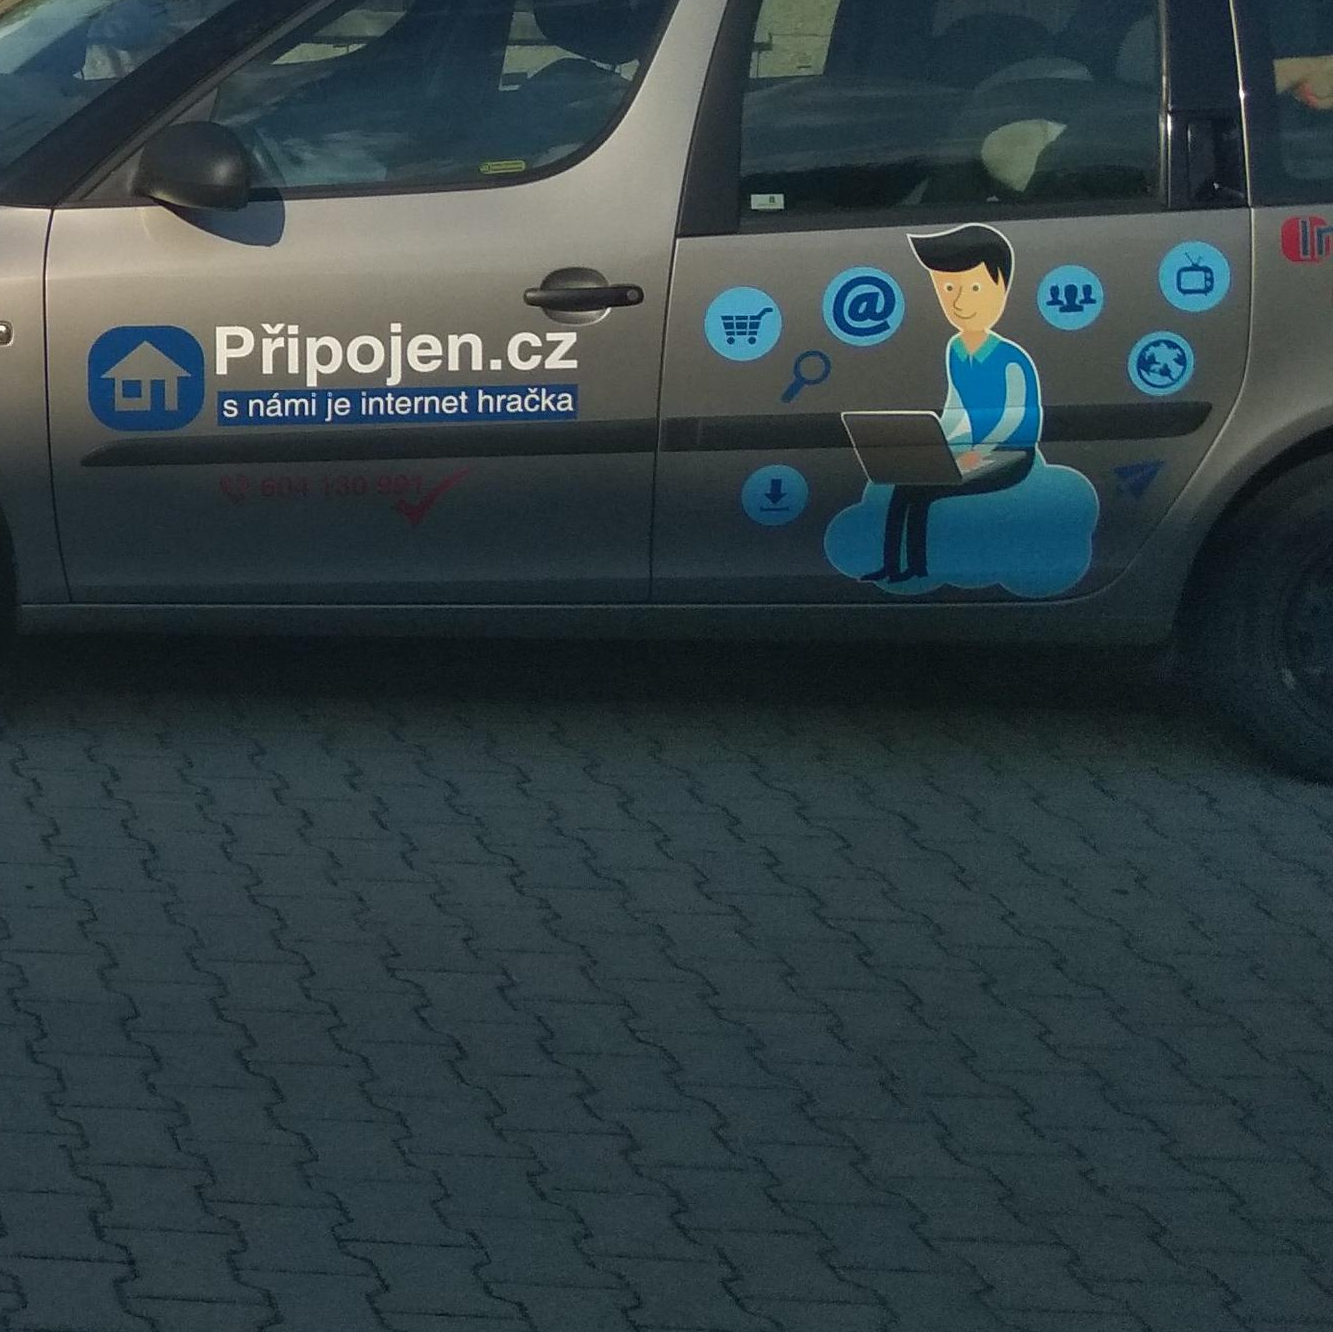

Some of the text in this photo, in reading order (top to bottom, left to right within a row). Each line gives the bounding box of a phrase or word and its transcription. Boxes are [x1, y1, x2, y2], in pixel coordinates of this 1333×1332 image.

[215, 322, 579, 387] Připojen.cz
[222, 387, 575, 422] s námi je internet hračka
